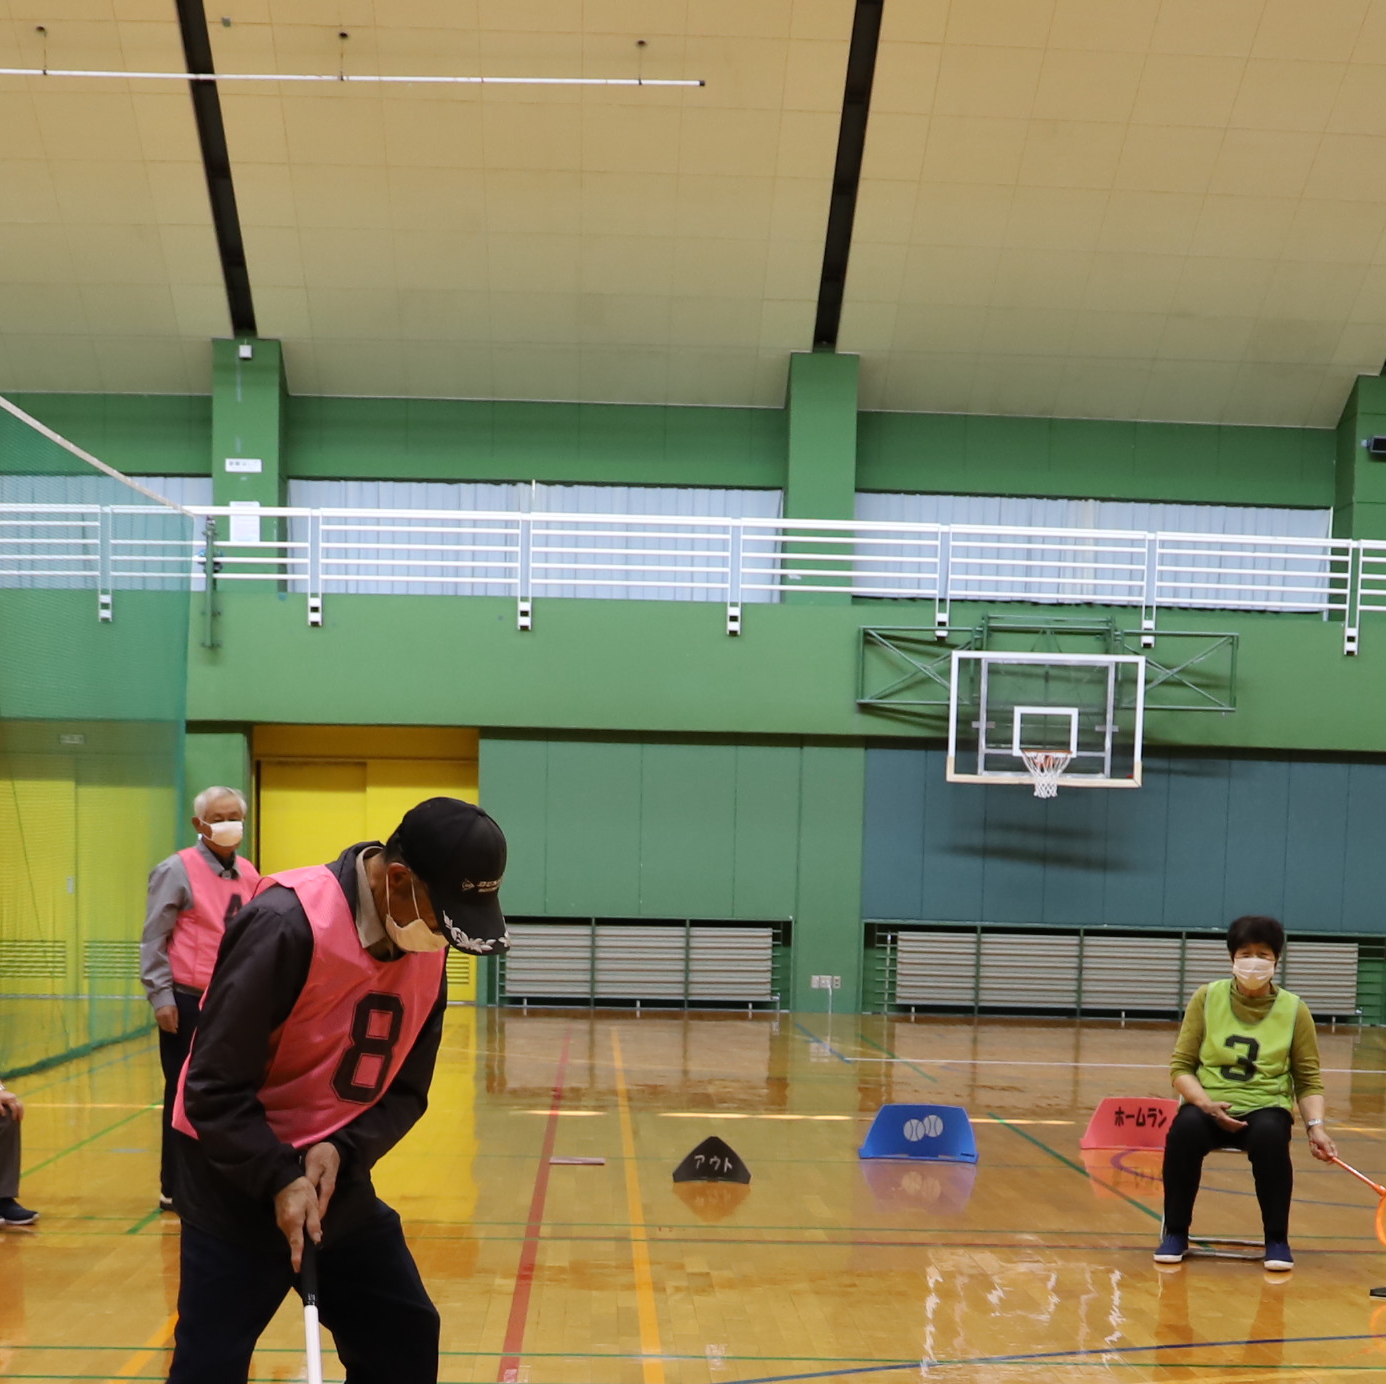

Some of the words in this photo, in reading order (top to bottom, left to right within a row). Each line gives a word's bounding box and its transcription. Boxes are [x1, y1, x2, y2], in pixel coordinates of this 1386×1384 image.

[331, 991, 404, 1104] 8
[1221, 1034, 1260, 1081] 3
[1115, 1106, 1167, 1128] ホームラン
[694, 1154, 733, 1173] アウト
